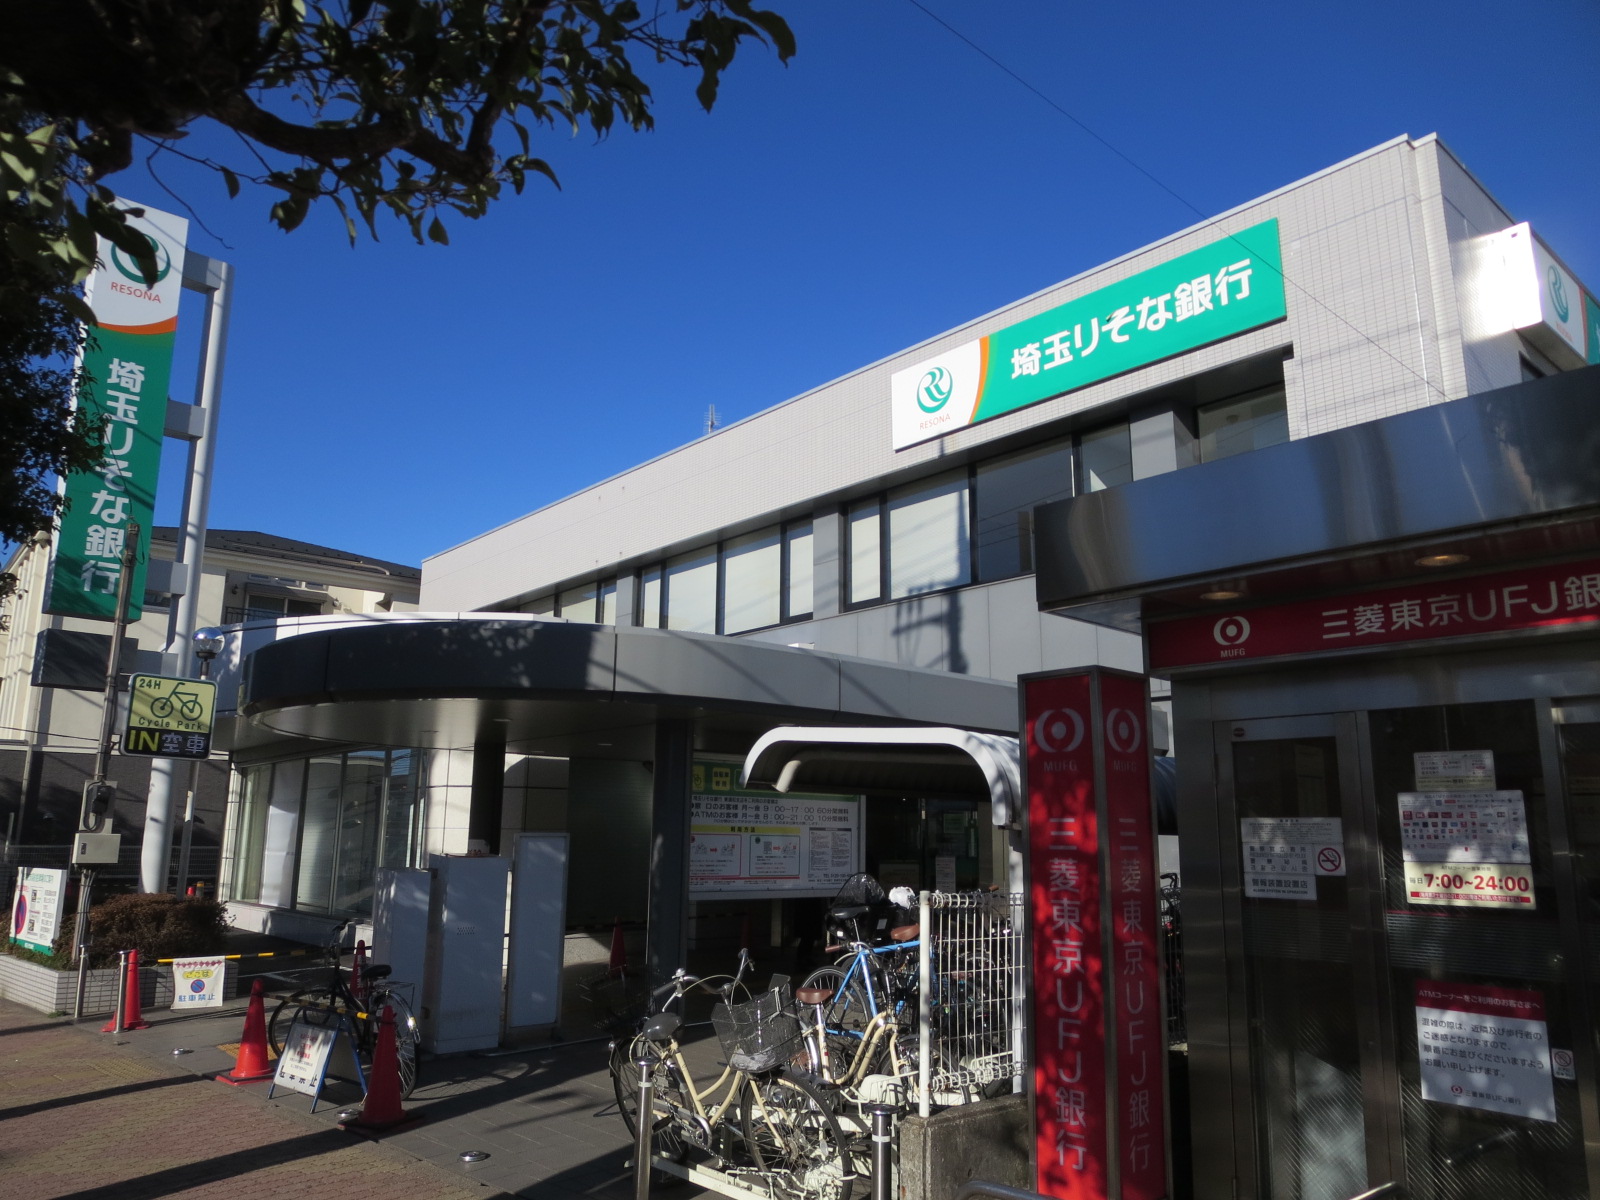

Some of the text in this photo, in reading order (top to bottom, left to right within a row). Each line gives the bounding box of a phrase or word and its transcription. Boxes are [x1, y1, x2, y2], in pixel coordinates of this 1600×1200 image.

[110, 281, 162, 304] RESONA
[1010, 258, 1253, 379] 埼玉りそな銀行
[919, 413, 951, 431] RESONA
[80, 357, 146, 595] 埼玉りそな銀行
[1220, 648, 1246, 658] MUFG
[139, 678, 161, 689] 24H
[138, 716, 203, 730] Cycle Park
[128, 729, 205, 754] IN 空車
[1043, 760, 1078, 773] MUFG
[1112, 760, 1138, 773] MUFG
[1424, 873, 1529, 892] 7:00~24:00
[186, 970, 209, 979] ここは
[178, 993, 216, 1002] 駐車禁止
[1048, 817, 1087, 1171] 三菱東京UFJ銀行
[1117, 816, 1151, 1174] 三菱東京UFJ銀行
[1418, 989, 1541, 1009] ATMコーナーをご利用のお客さまへ
[1423, 1031, 1512, 1051] ご迷惑となりますので、
[1423, 1044, 1544, 1070] 順番にお並びくださいますよう
[1424, 1057, 1506, 1079] お願い申し上げます。
